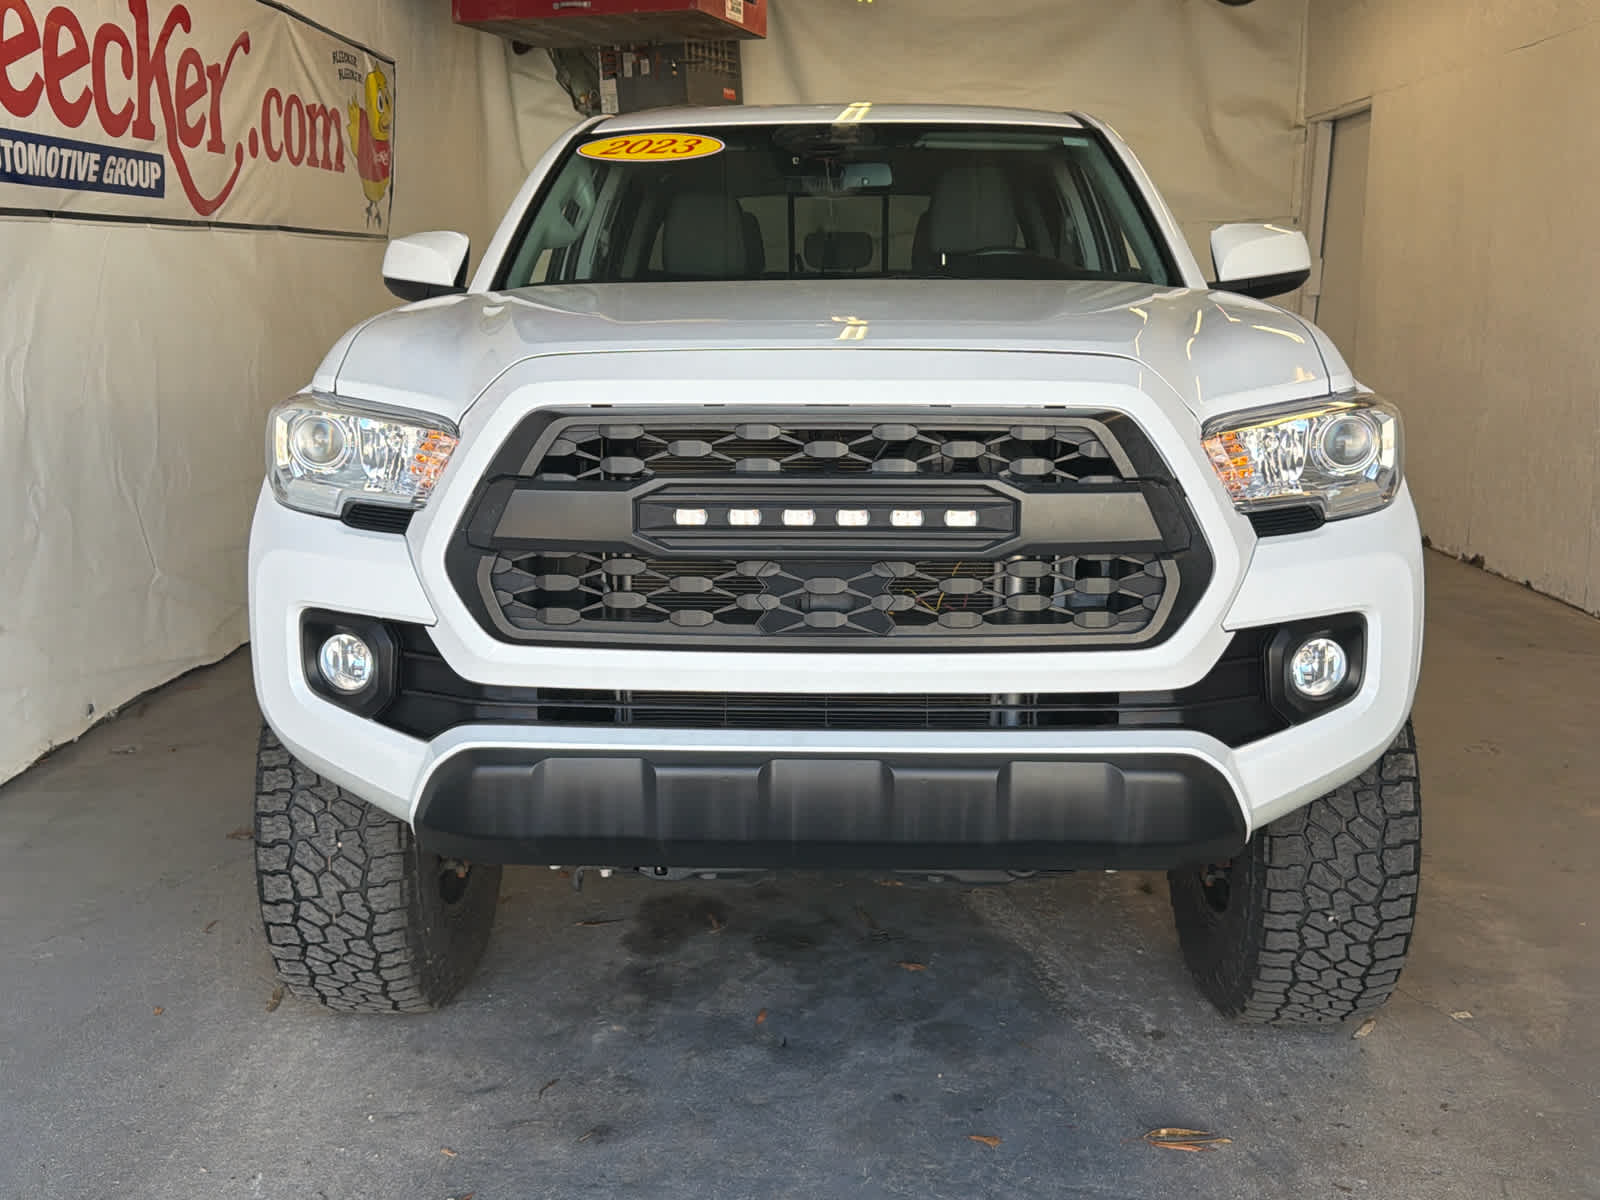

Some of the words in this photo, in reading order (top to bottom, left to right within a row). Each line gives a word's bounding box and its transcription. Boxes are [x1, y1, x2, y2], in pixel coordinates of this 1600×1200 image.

[599, 139, 702, 155] 2023
[0, 139, 101, 183] TOMOTIVE
[102, 155, 161, 189] GROUP
